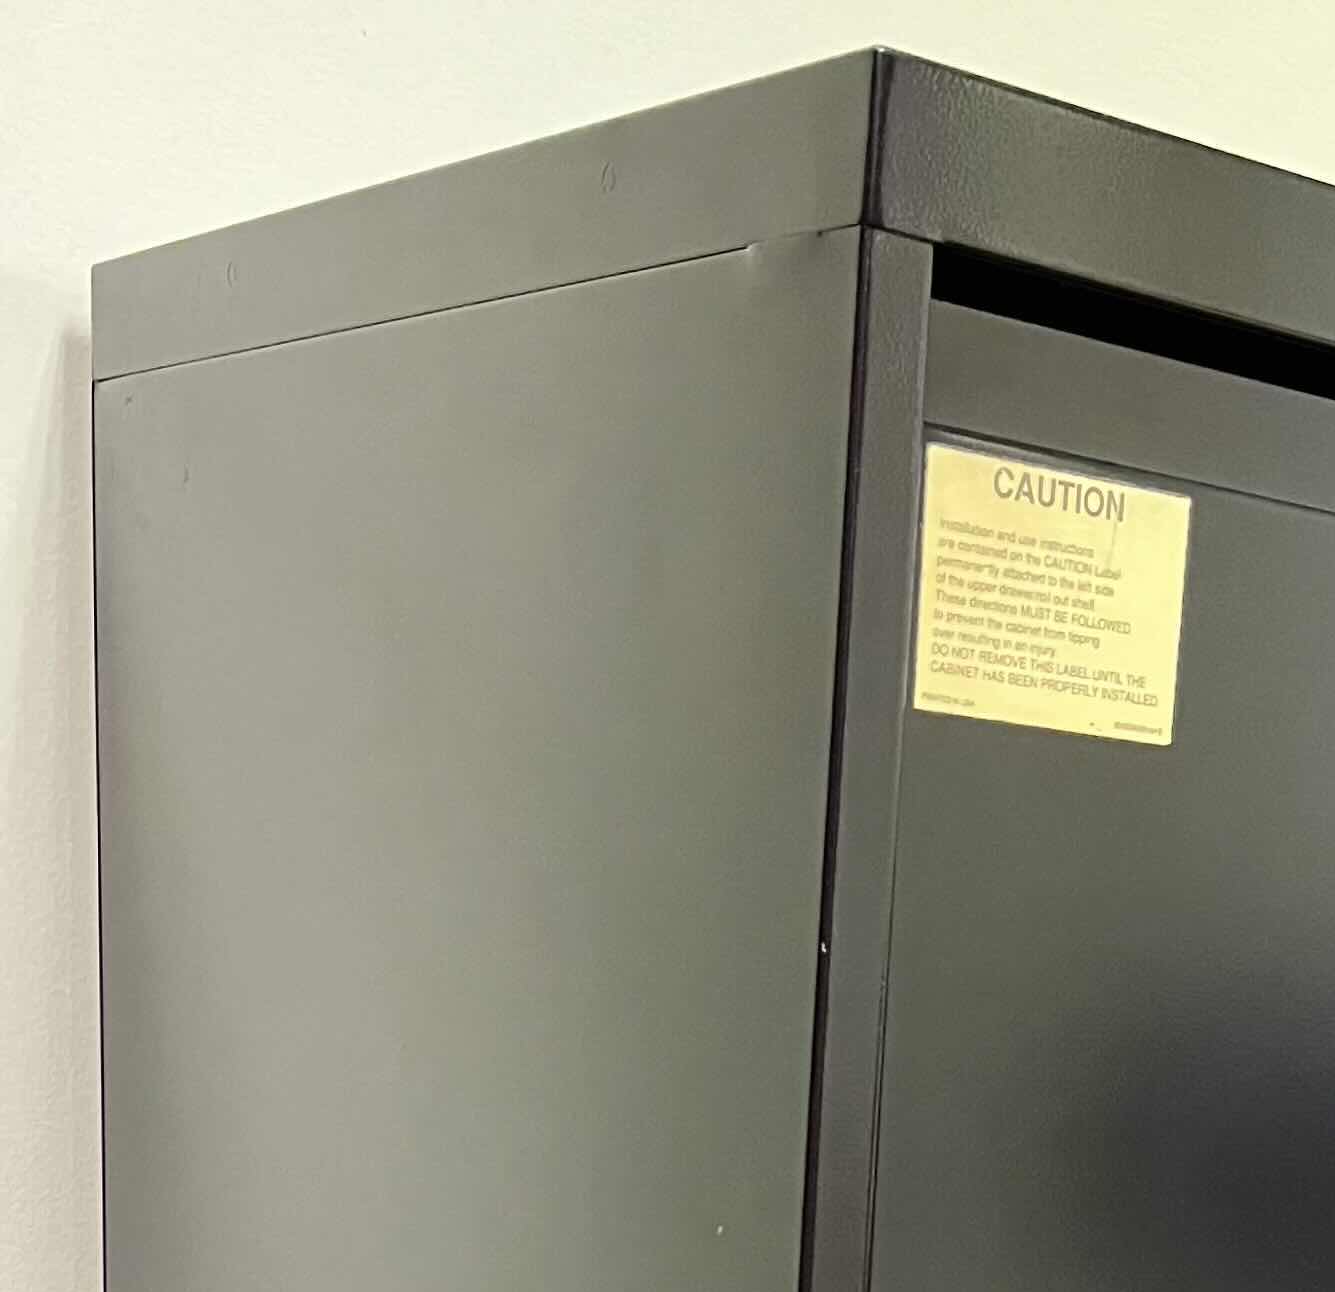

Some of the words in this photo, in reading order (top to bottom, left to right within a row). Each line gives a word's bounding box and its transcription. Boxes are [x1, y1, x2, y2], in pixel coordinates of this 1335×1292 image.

[993, 466, 1126, 522] CAUTION
[937, 537, 955, 549] are
[958, 541, 1008, 560] contained
[1009, 551, 1023, 561] on
[1025, 552, 1041, 567] the
[1044, 554, 1092, 576] CAUTION
[997, 530, 1016, 543] and
[1018, 535, 1037, 547] use
[1040, 539, 1094, 559] instructions
[935, 571, 946, 584] of
[948, 574, 965, 588] the
[967, 580, 998, 593] upper
[1053, 595, 1069, 607] out
[936, 555, 1000, 579] permanently
[1002, 567, 1046, 585] attached
[1048, 575, 1057, 587] to
[1059, 575, 1074, 590] the
[1077, 579, 1092, 593] left
[1095, 584, 1115, 598] side
[932, 607, 944, 620] to
[946, 611, 985, 626] prevent
[987, 616, 1003, 630] the
[1005, 622, 1042, 636] cabinet
[1044, 626, 1066, 640] from
[1068, 631, 1101, 650] tipping
[935, 588, 967, 606] These
[969, 595, 1018, 616] directions
[1020, 604, 1051, 620] MUST
[1054, 609, 1069, 624] BE
[1071, 613, 1131, 635] FOLLOWED
[931, 626, 955, 640] over
[957, 631, 1001, 650] resulting
[1003, 639, 1012, 649] in
[1014, 640, 1028, 651] an
[930, 659, 980, 679] CABINET
[982, 670, 1005, 684] HAS
[1007, 672, 1038, 688] BEEN
[1040, 677, 1098, 698] PROPERLY
[931, 641, 950, 657] DO
[952, 646, 976, 660] NOT
[978, 650, 1027, 670] REMOVE
[1030, 658, 1054, 674] THIS
[1056, 663, 1090, 679] LABEL
[1092, 670, 1122, 686] UNTIL
[1126, 673, 1146, 688] THE
